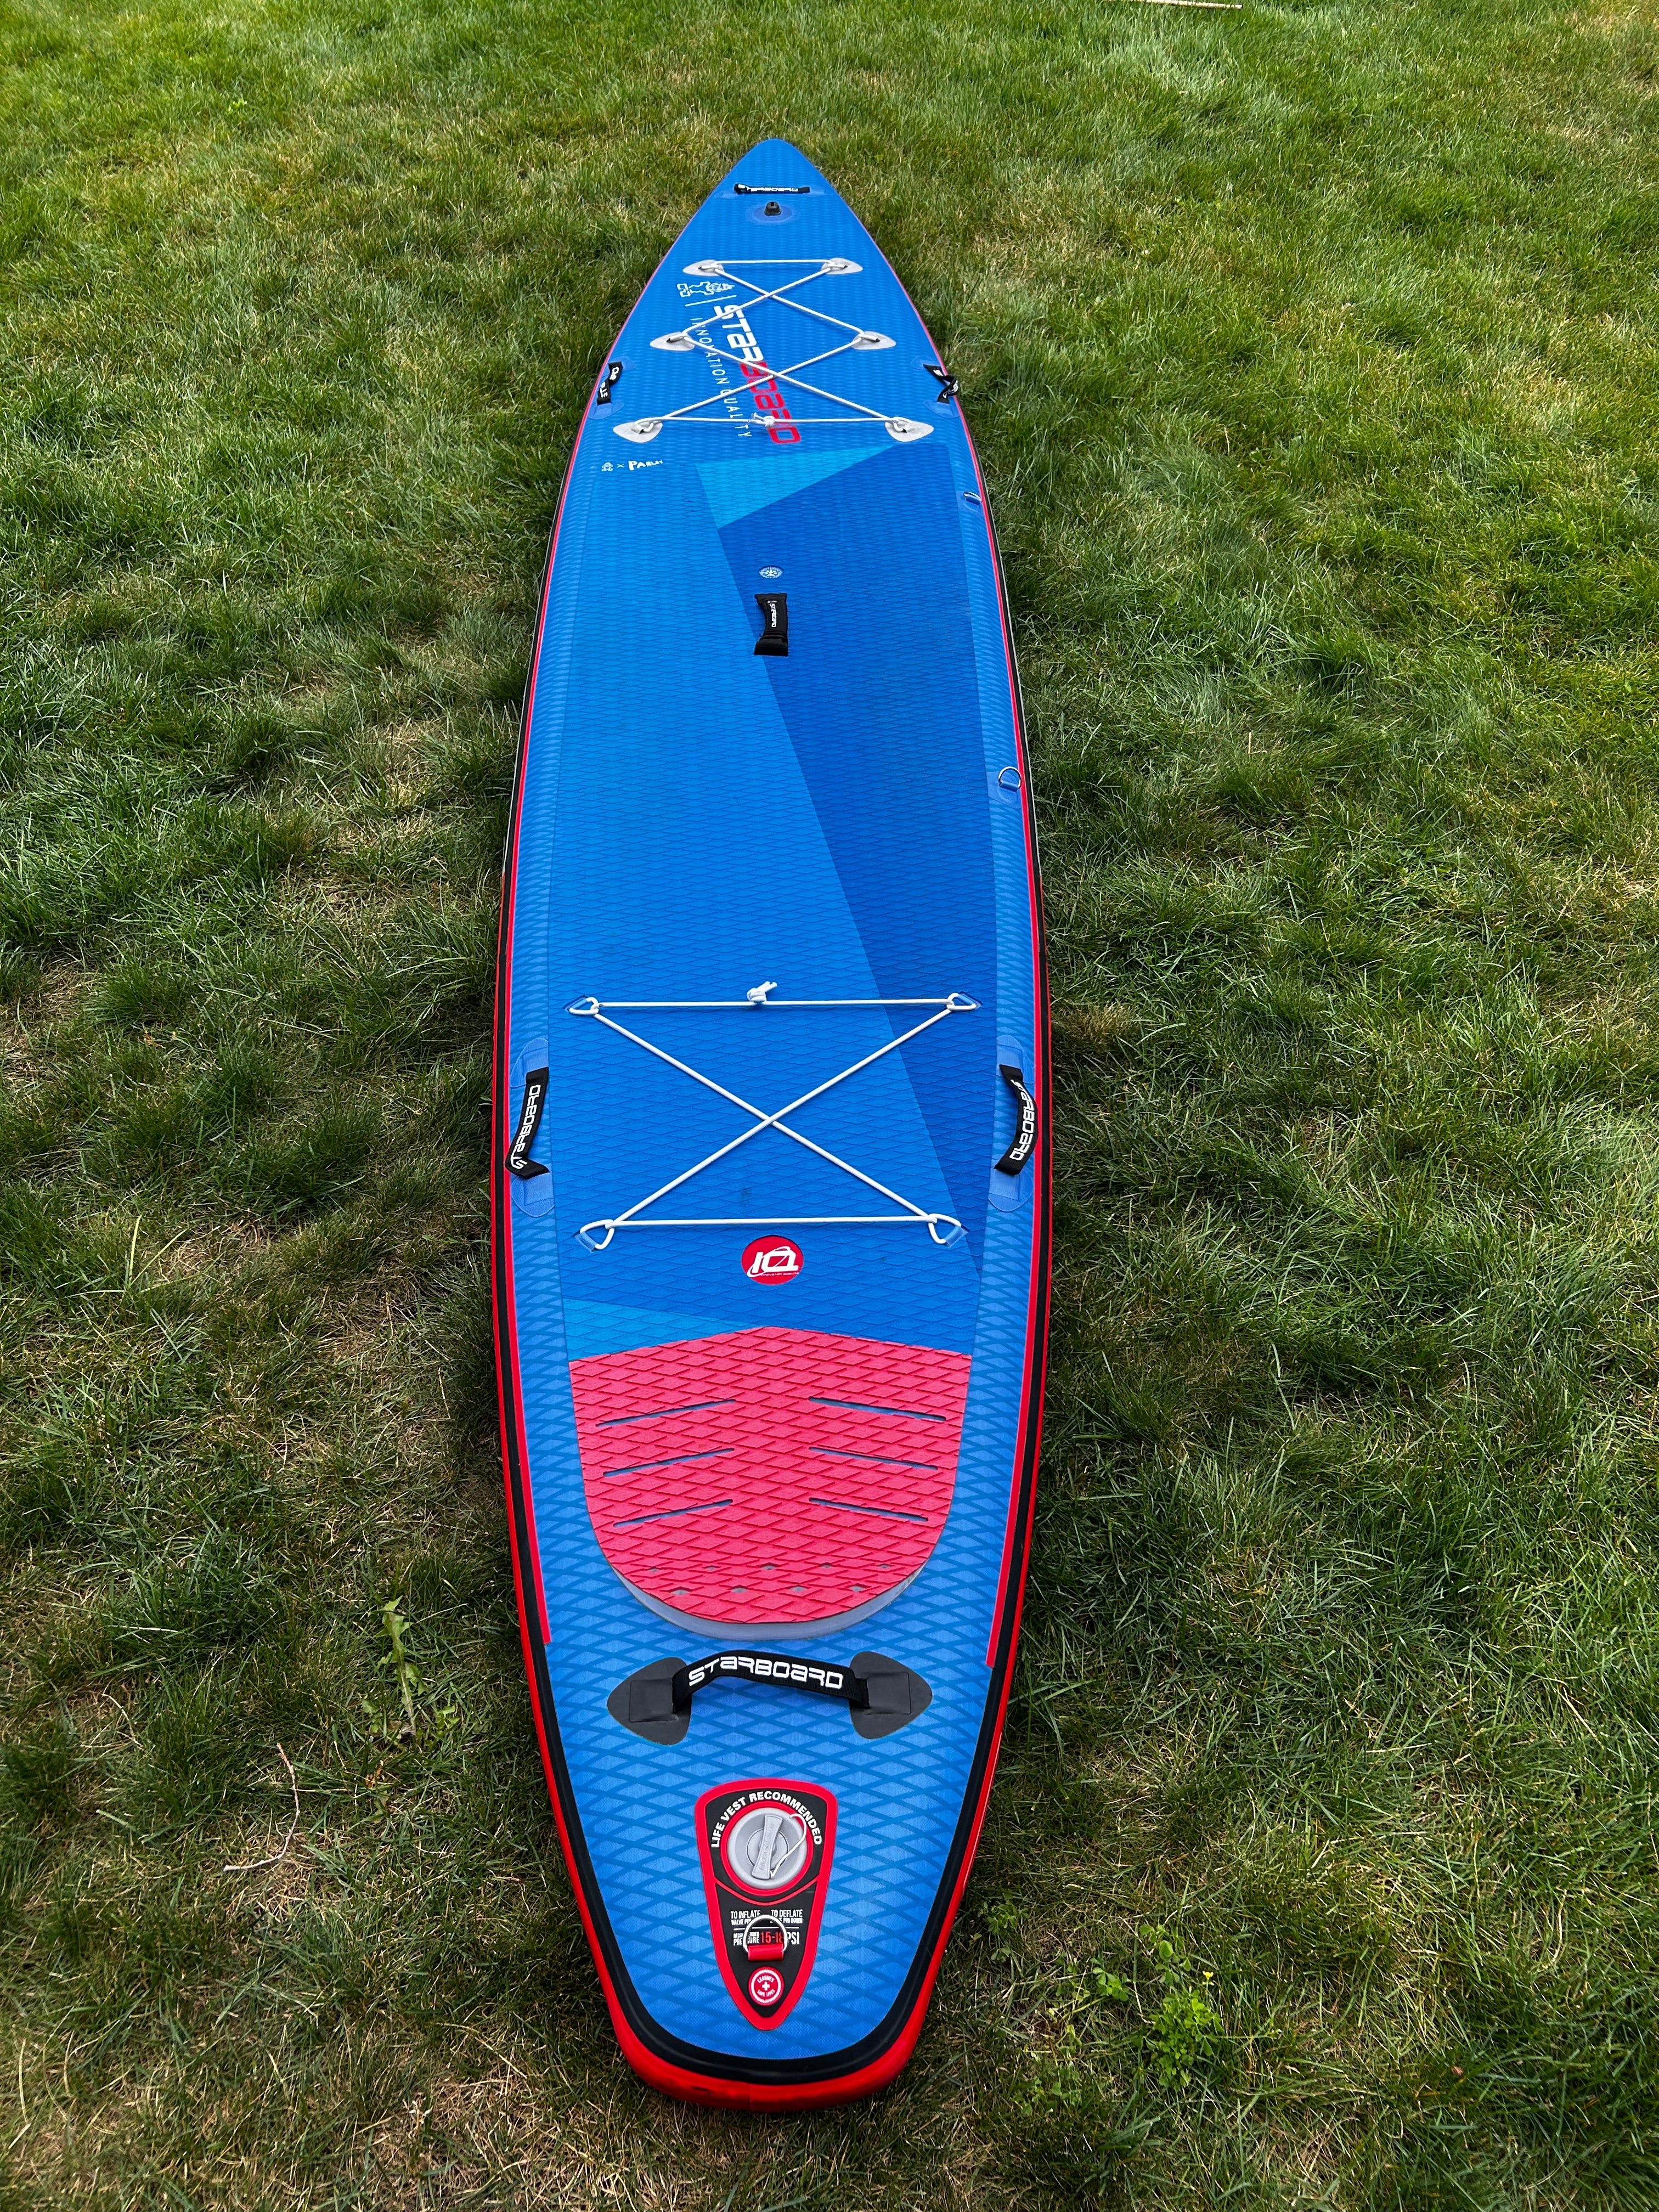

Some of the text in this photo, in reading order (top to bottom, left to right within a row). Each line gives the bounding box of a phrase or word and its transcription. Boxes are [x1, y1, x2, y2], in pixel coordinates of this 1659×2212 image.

[720, 389, 752, 437] QUALTY
[689, 1656, 843, 1690] STARBOARD
[711, 1791, 822, 1848] LIFE VEST RECOMMENDED
[730, 1909, 761, 1919] TO INFLATE
[770, 1909, 803, 1917] TO DEFLATE
